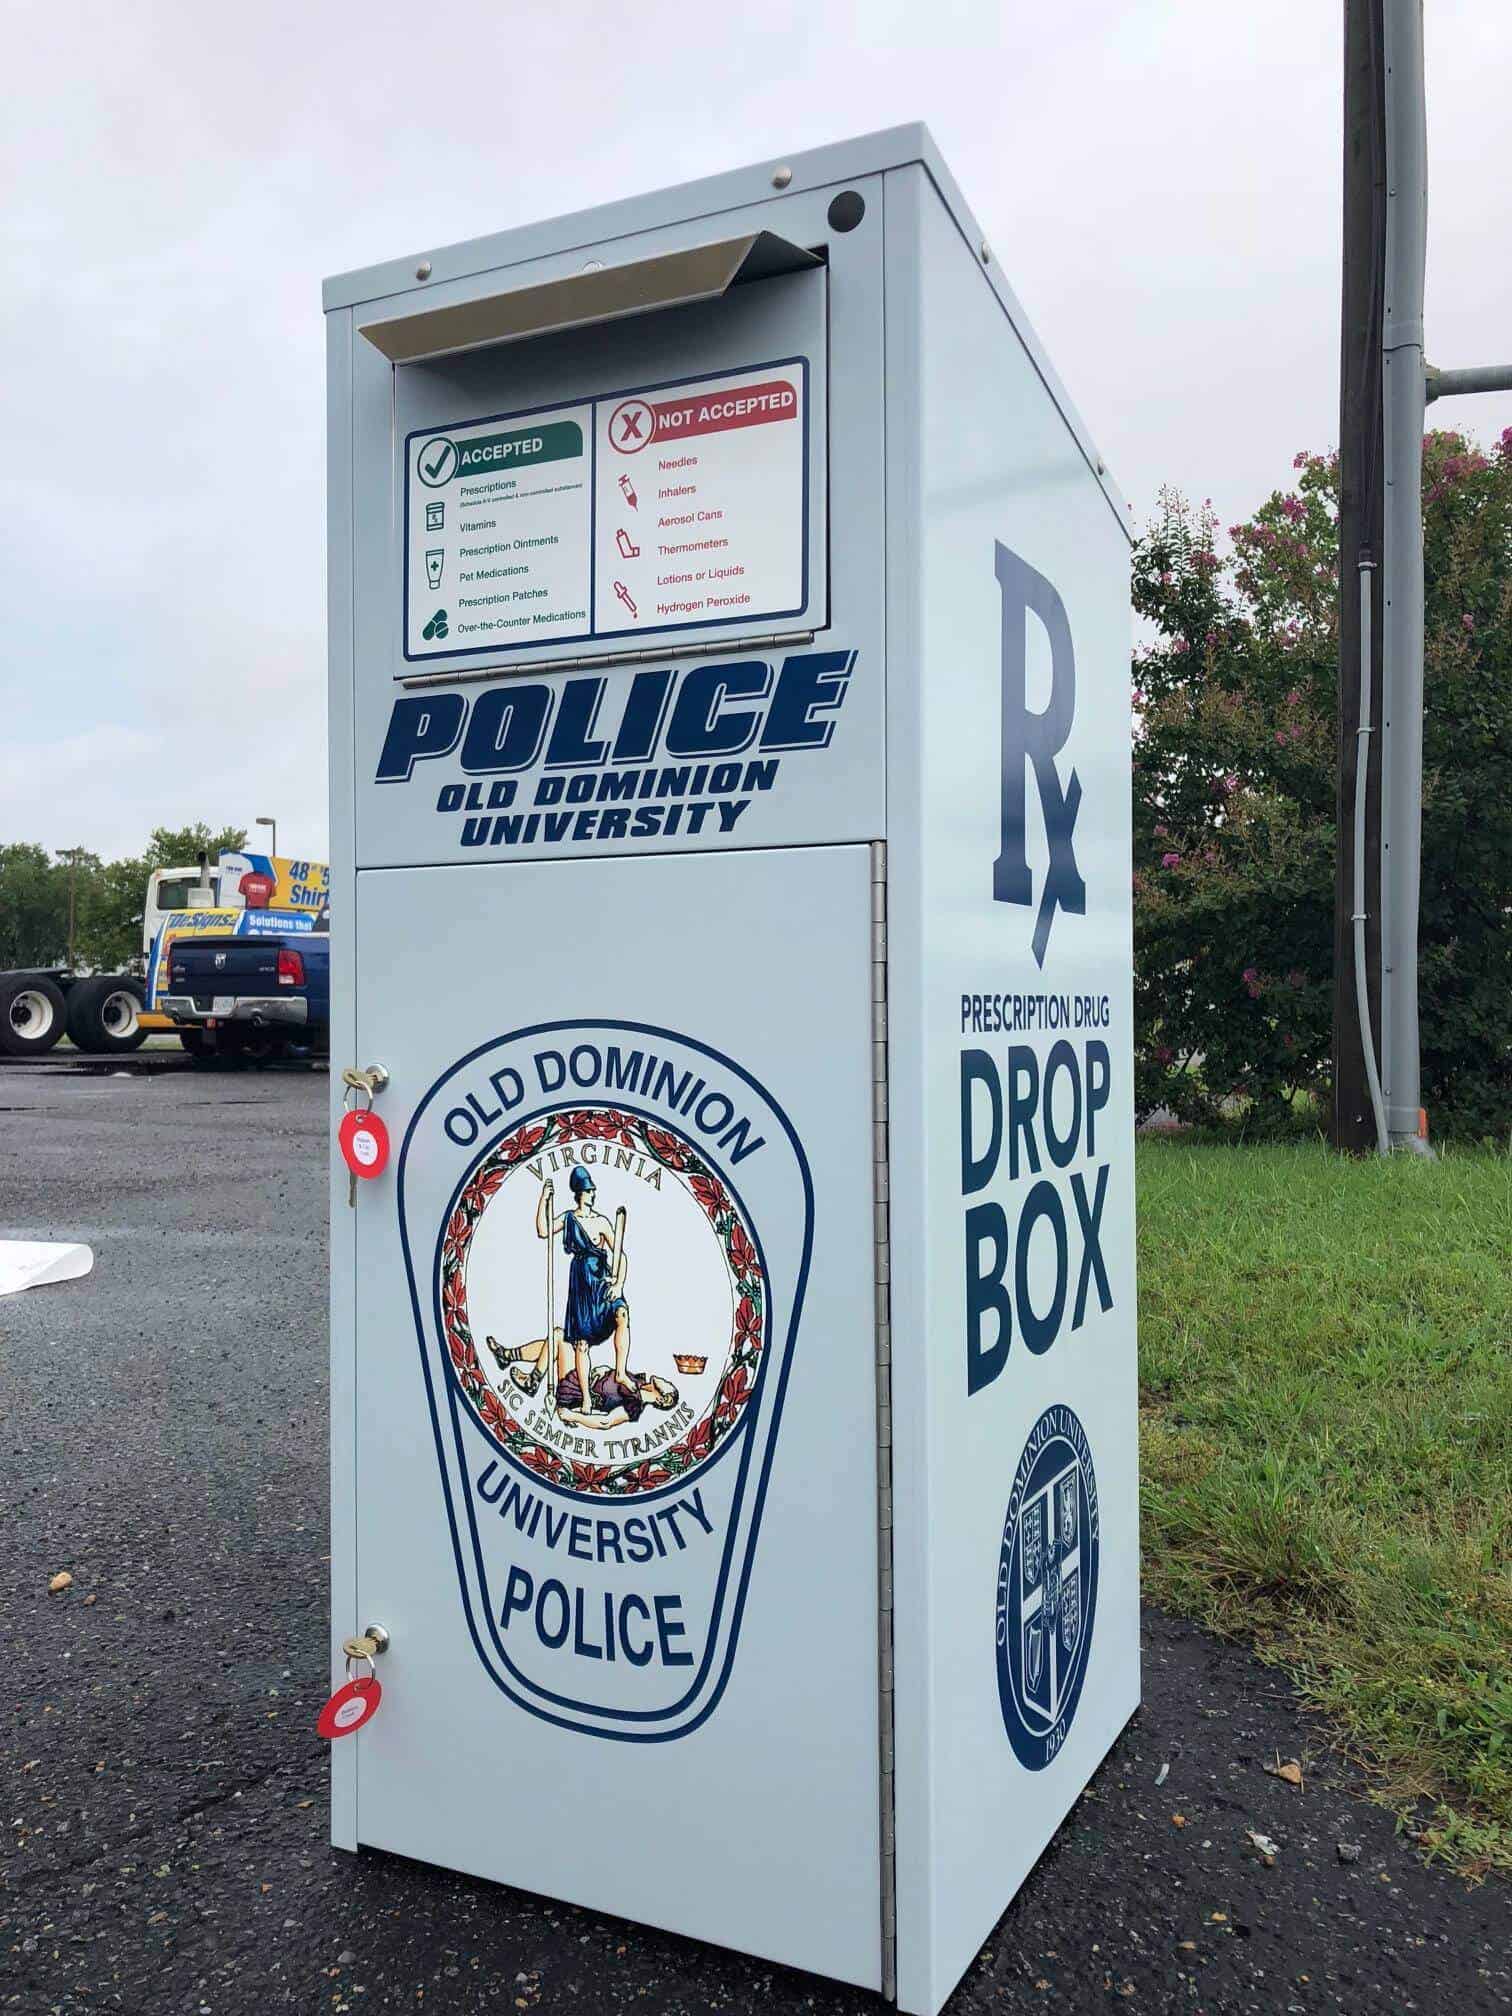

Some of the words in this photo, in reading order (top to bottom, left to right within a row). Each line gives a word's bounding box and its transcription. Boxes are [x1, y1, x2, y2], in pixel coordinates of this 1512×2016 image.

[658, 409, 694, 430] NOT
[698, 391, 793, 422] ACCEPTED
[461, 437, 543, 466] ACCEPTED
[658, 456, 698, 471] Needles
[460, 480, 517, 497] Prescriptions
[658, 484, 697, 499] Inhalers
[460, 519, 497, 532] Vitamins
[658, 513, 695, 528] Aerosol
[697, 510, 723, 521] Cans
[460, 542, 511, 558] Prescription
[512, 535, 559, 550] Ointments
[658, 538, 728, 555] Thermometers
[460, 572, 474, 582] Pet
[476, 564, 529, 580] Medications
[657, 573, 693, 586] Lotions
[695, 572, 706, 581] or
[708, 565, 745, 580] Liquids
[458, 593, 510, 608] Prescription
[512, 587, 549, 601] Patches
[657, 600, 704, 616] Hydrogen
[706, 593, 751, 608] Peroxide
[457, 616, 531, 633] Over-the-Counter
[532, 609, 587, 624] Medications
[374, 648, 859, 785] POLICE
[436, 779, 519, 812] OLD
[533, 759, 780, 807] DOMINION
[460, 800, 752, 847] UNIVERSITY
[289, 861, 310, 882] 48
[249, 915, 294, 929] Solutions
[960, 994, 1069, 1033] PRESCRIPTION
[1074, 995, 1110, 1028] DRUG
[444, 1067, 525, 1147] OLD
[533, 1044, 766, 1165] DOMINION
[960, 1039, 1111, 1196] DROP
[526, 1143, 662, 1191] VIRGINIA
[965, 1164, 1114, 1398] BOX
[497, 1379, 524, 1411] SIC
[524, 1410, 599, 1458] SEMPER
[604, 1401, 696, 1460] TYRANNIS
[476, 1460, 715, 1564] UNIVERSITY
[996, 1562, 1009, 1647] OLD
[1003, 1409, 1057, 1549] DOMINION
[1060, 1408, 1099, 1541] UNIVERSITY
[500, 1565, 694, 1667] POLICE
[1045, 1718, 1067, 1760] 1930
